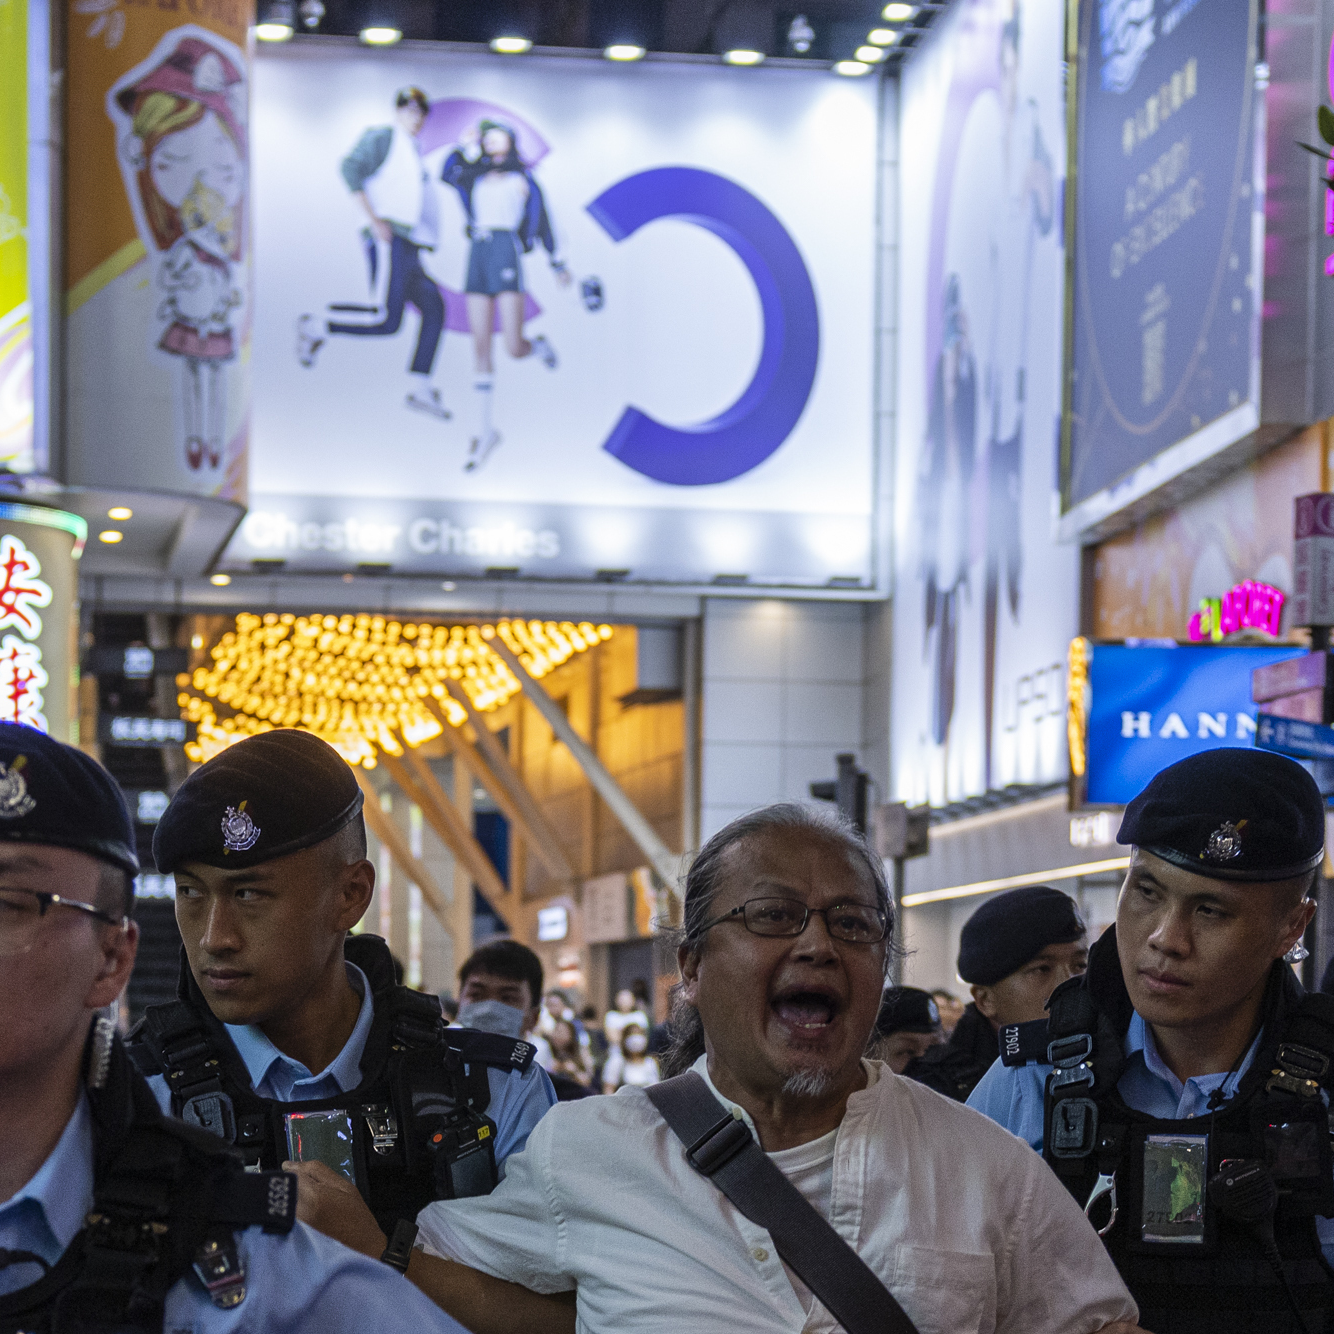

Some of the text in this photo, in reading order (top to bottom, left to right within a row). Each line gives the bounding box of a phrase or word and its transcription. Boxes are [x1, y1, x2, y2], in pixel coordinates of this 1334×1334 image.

[244, 511, 560, 559] Chester Charles
[509, 1041, 530, 1064] 27649
[1005, 1026, 1020, 1056] 27902
